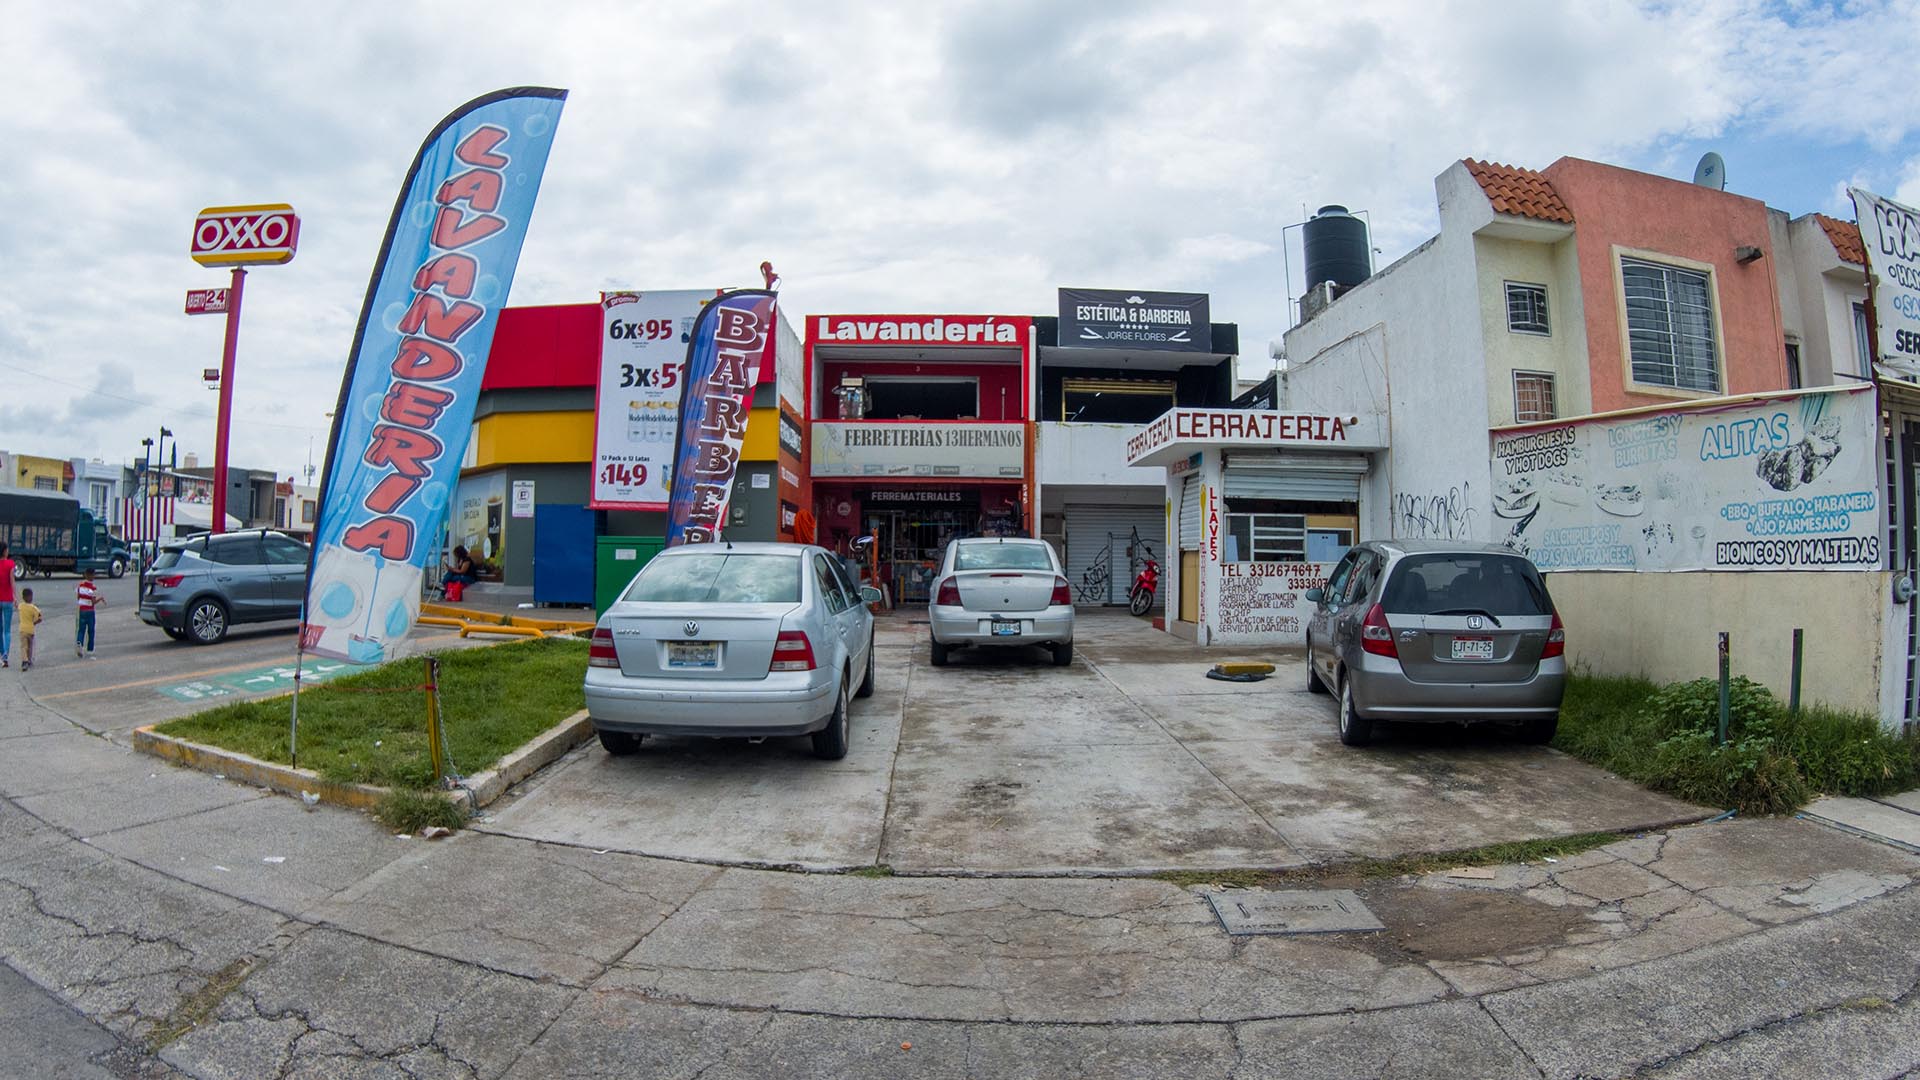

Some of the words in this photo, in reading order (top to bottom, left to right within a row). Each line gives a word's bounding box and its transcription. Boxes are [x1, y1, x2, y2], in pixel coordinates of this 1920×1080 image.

[196, 214, 289, 251] OXXO
[206, 289, 225, 303] 24
[1076, 303, 1127, 322] ESTÉTICA
[1129, 308, 1137, 322] &
[1140, 308, 1191, 324] BARBERIA
[818, 317, 1017, 342] Lavandería
[1105, 331, 1133, 340] JORGE
[1135, 332, 1167, 342] FLORES
[341, 123, 511, 562] LAVANDERIA
[844, 427, 943, 447] FERRETERÍAS
[1176, 412, 1345, 441] CERRAJERIA
[1608, 416, 1669, 448] LONCHES
[1669, 414, 1683, 435] Y
[1700, 413, 1789, 461] ALITAS
[1127, 415, 1174, 461] CERRAJERIA
[1497, 426, 1576, 458] HAMBURGUESAS
[1505, 460, 1515, 475] Y
[1515, 456, 1537, 474] HOT
[1538, 448, 1568, 470] DOGS
[600, 463, 648, 486] $149
[871, 491, 961, 501] FERREMATERIALES
[1727, 503, 1750, 520] BBQ
[1757, 498, 1807, 518] BUFFALO
[1209, 487, 1219, 561] LLAVES
[1753, 519, 1777, 535] AJO
[1777, 513, 1849, 534] PARMESANO
[1584, 545, 1636, 565] FRANCESA
[1717, 540, 1785, 564] BIONICOS
[1786, 540, 1800, 564] Y
[1801, 536, 1880, 564] MALTEDAS
[1220, 564, 1242, 577] TEL
[1219, 586, 1259, 595] APERTURAS
[1220, 577, 1263, 587] DUPLICADOS
[1219, 594, 1247, 602] CAMBIOS
[1249, 593, 1256, 601] DE
[1234, 609, 1251, 618] CHIP
[1218, 625, 1252, 634] SERVICIO
[1453, 641, 1493, 652] EJT-71-25
